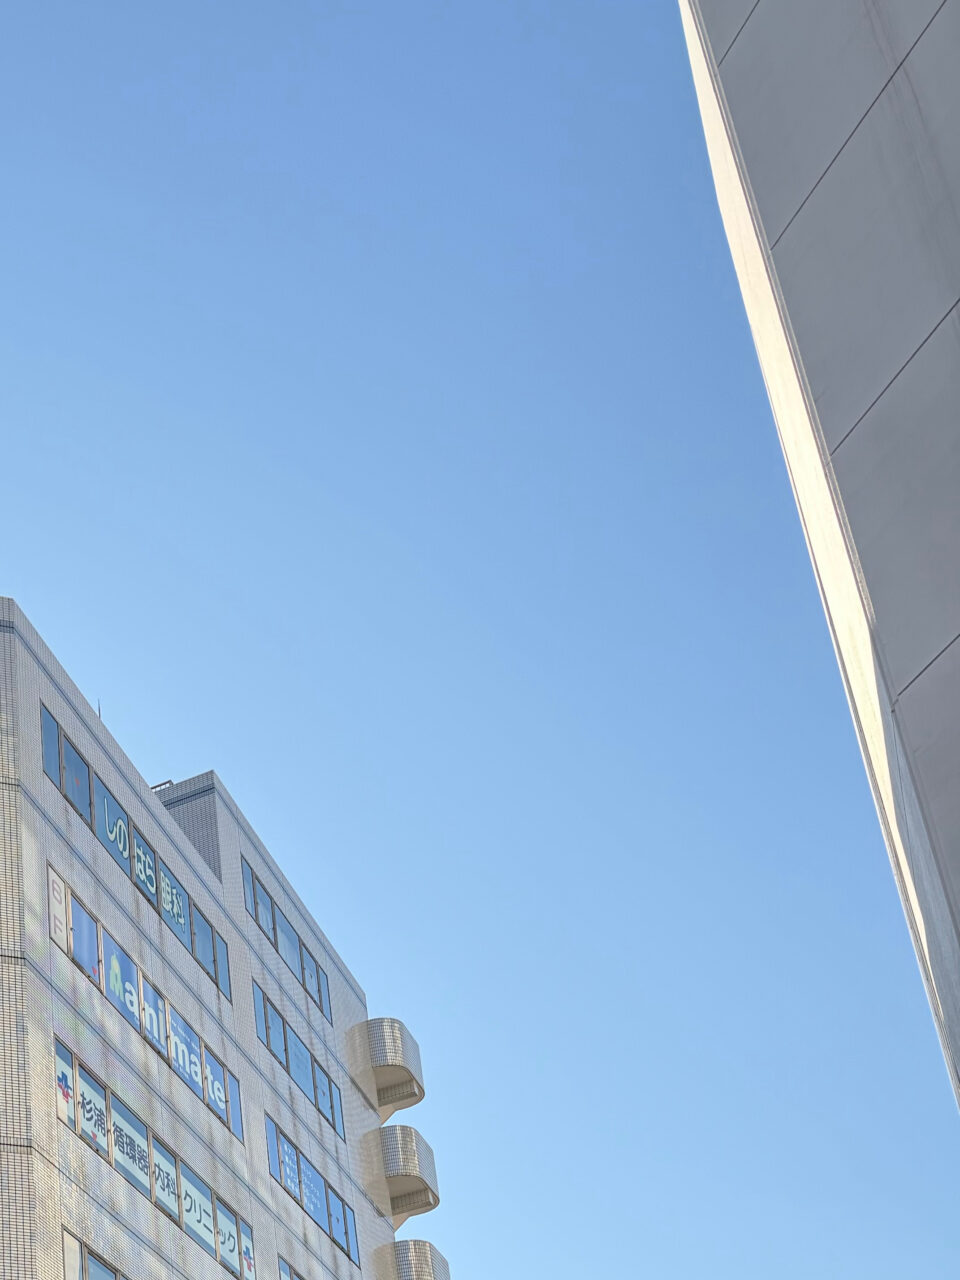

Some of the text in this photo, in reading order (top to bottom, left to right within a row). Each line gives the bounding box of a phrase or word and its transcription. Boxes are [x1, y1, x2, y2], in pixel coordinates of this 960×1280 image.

[104, 797, 186, 933] しのはら眼科
[123, 981, 227, 1110] animate
